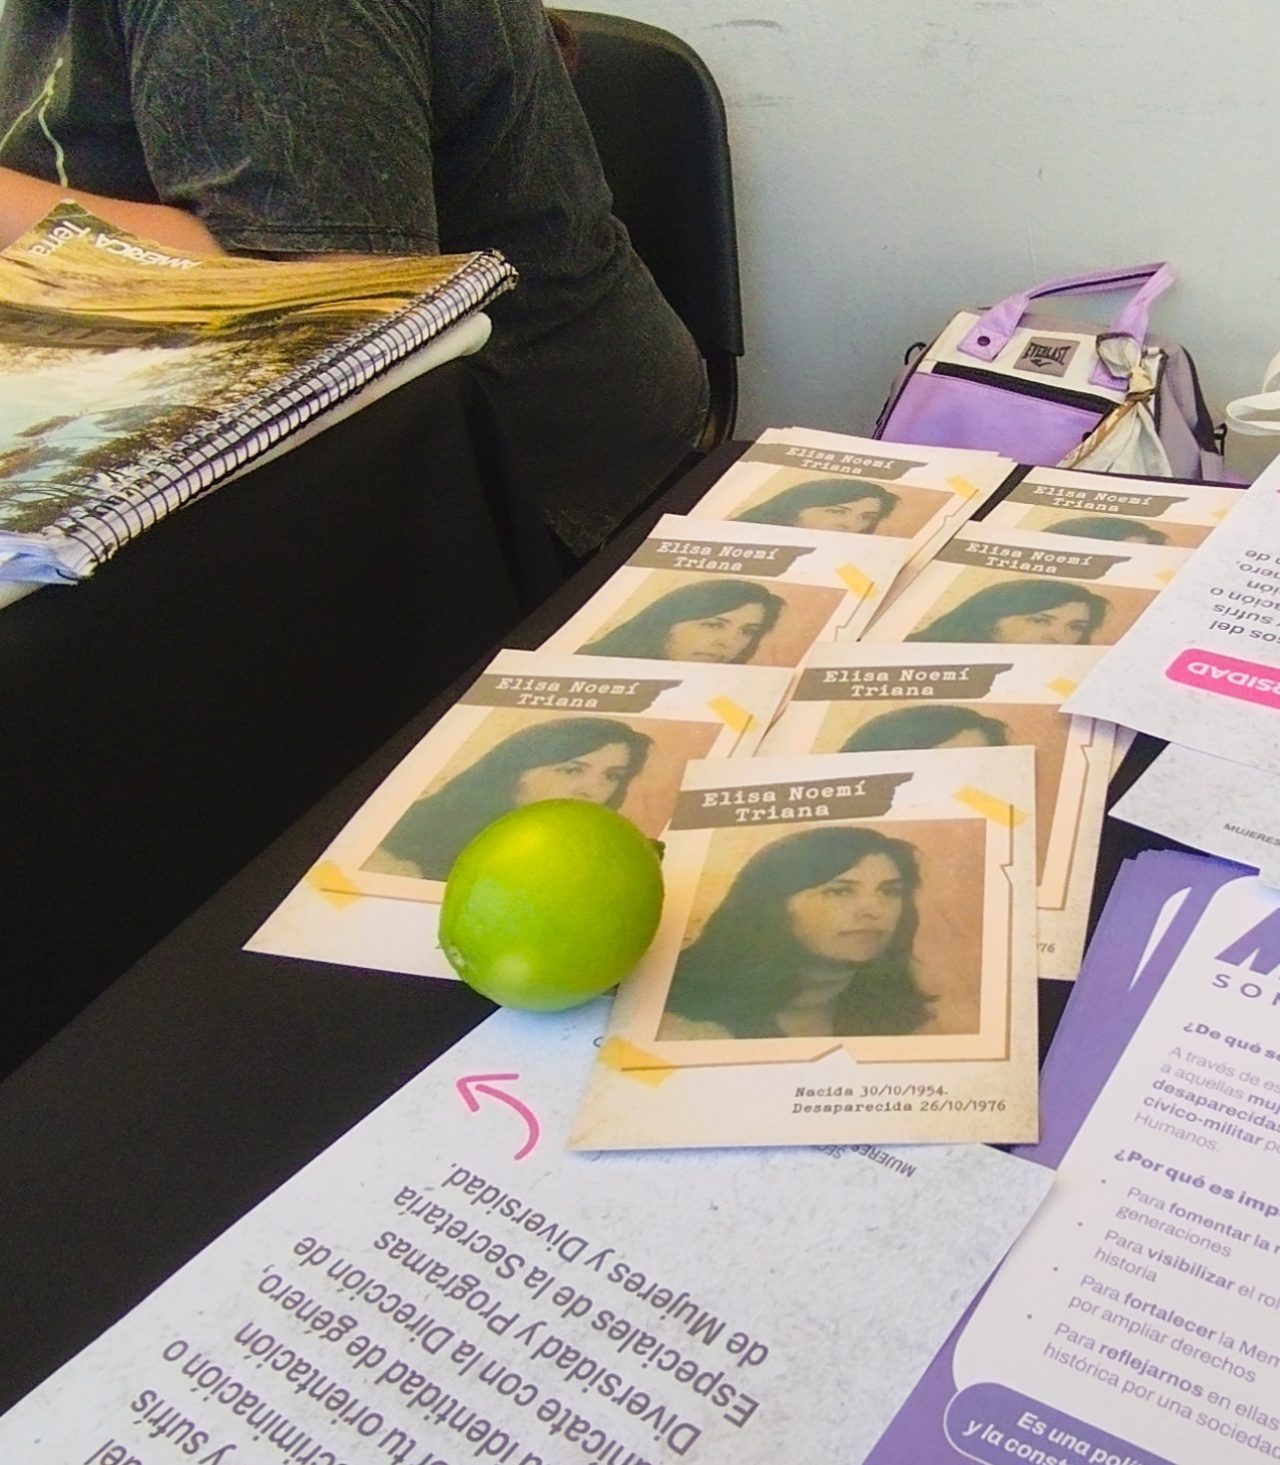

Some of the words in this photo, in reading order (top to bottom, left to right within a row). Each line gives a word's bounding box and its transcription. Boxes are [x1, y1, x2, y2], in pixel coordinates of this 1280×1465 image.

[1022, 342, 1071, 365] EVERLAST
[787, 447, 837, 461] Elisa
[840, 454, 896, 469] Noemí
[801, 460, 862, 474] Triana
[1034, 486, 1088, 499] Elisa
[1095, 489, 1152, 506] Noemí
[1053, 498, 1119, 512] Triana
[657, 542, 712, 556] Elisa
[719, 546, 779, 560] Noemí
[966, 542, 1023, 558] Elisa
[1032, 550, 1092, 566] Noemí
[674, 557, 742, 571] Triana
[986, 558, 1058, 574] Triana
[1213, 604, 1273, 625] sufrís
[1209, 621, 1245, 635] del
[496, 678, 560, 692] Elisa
[570, 682, 640, 694] Noemí
[824, 670, 889, 682] Elisa
[899, 668, 970, 681] Noemí
[517, 694, 598, 708] Triana
[851, 684, 934, 697] Triana
[702, 789, 776, 808] Elisa
[789, 780, 866, 801] Noemí
[736, 805, 830, 822] Triana
[1182, 1021, 1221, 1041] ¿De
[1223, 1034, 1260, 1058] qué
[1168, 1046, 1185, 1060] A
[1186, 1051, 1236, 1078] través
[1238, 1065, 1260, 1083] de
[795, 1086, 853, 1097] Nacida
[860, 1085, 948, 1097] 30/10/1954.
[1160, 1063, 1170, 1074] a
[1173, 1070, 1244, 1102] aquellas
[792, 1102, 912, 1115] Desaparecida
[920, 1100, 1006, 1112] 26/10/1976
[1114, 1149, 1164, 1175] ¿Por
[1165, 1166, 1206, 1188] qué
[1209, 1181, 1234, 1200] es
[441, 1162, 590, 1264] Diversidad.
[1127, 1186, 1165, 1210] Para
[1168, 1202, 1252, 1242] fomentar
[1254, 1234, 1271, 1252] la
[393, 1185, 527, 1279] Secretaría
[588, 1248, 615, 1273] y
[373, 1230, 513, 1336] Programas
[524, 1270, 555, 1297] la
[552, 1284, 594, 1318] de
[607, 1261, 727, 1347] Mujeres
[516, 1320, 548, 1346] y
[726, 1331, 769, 1368] de
[591, 1309, 760, 1429] Especiales
[530, 1336, 702, 1456] Diversidad
[1016, 1411, 1047, 1435] Es
[1048, 1429, 1091, 1456] una
